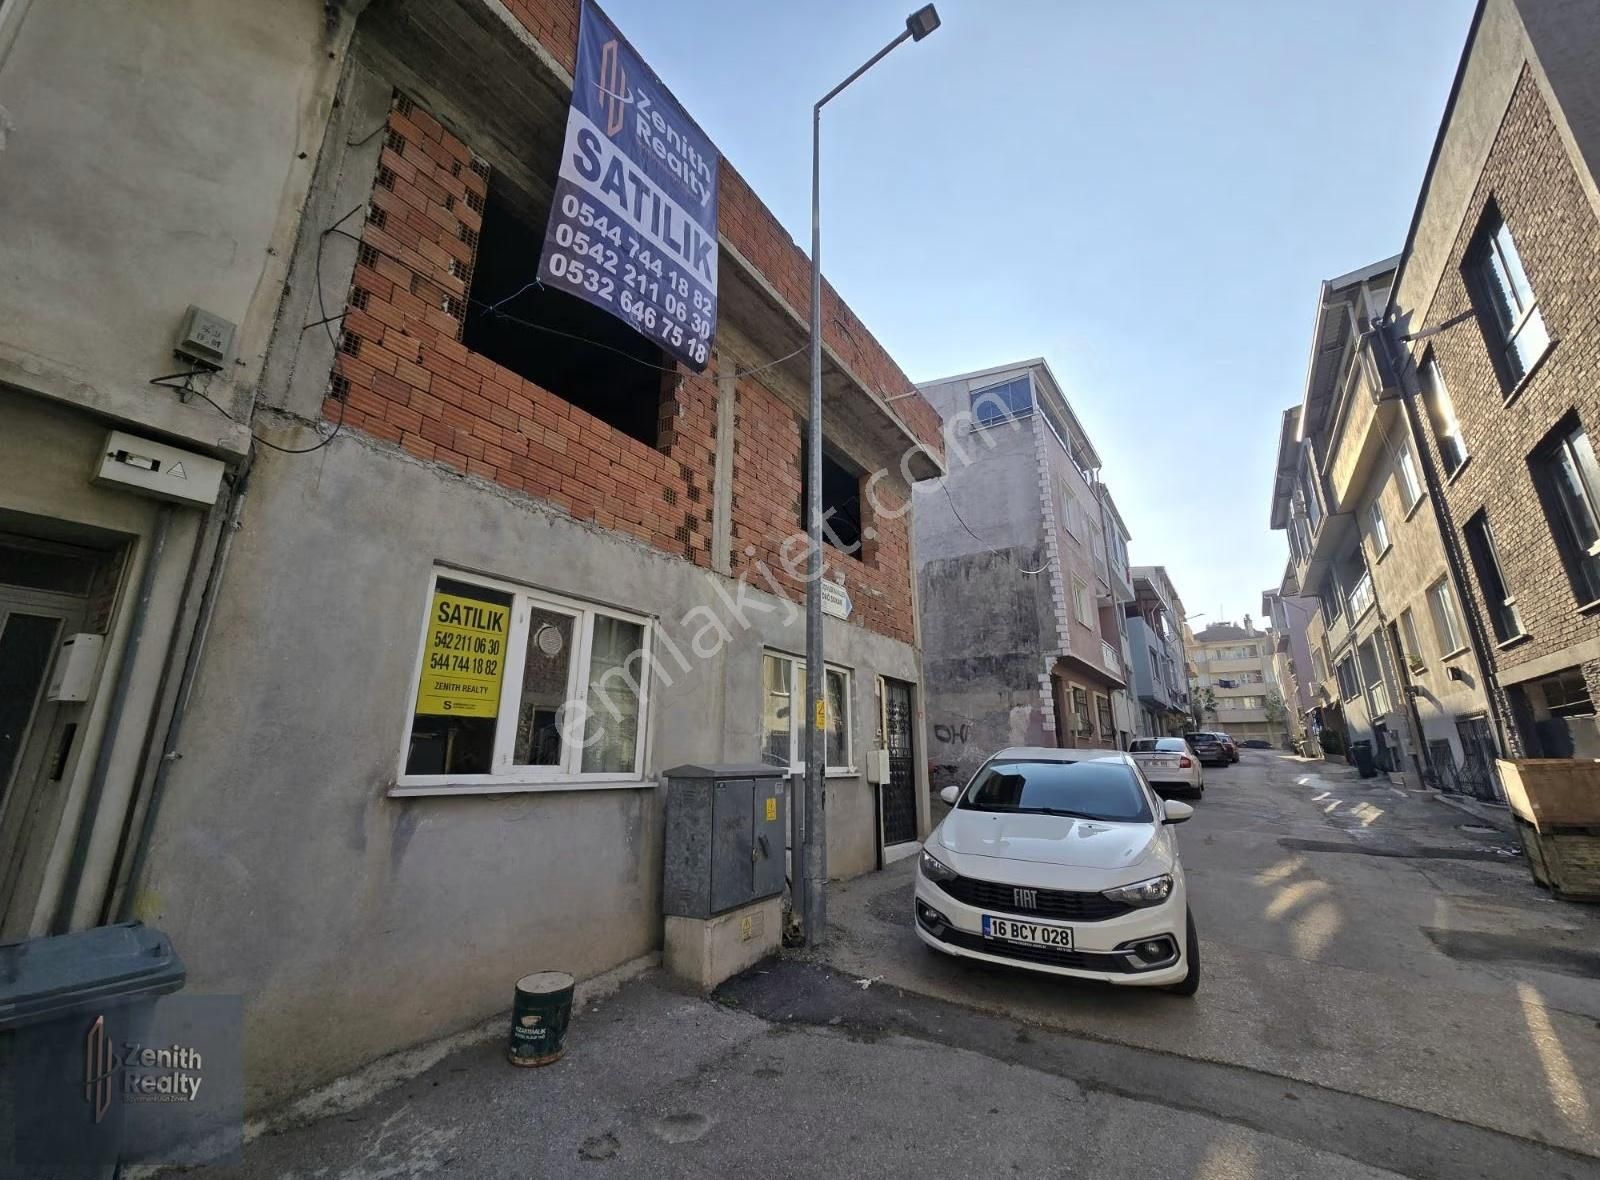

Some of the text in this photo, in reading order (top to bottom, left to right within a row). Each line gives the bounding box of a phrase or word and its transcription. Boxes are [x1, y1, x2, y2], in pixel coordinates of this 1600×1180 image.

[636, 113, 710, 207] Realty
[637, 88, 710, 183] Zenith
[573, 128, 713, 284] SATILIK
[556, 224, 710, 339] 0542 211 06 30
[562, 194, 712, 317] 0544 744 18 82
[549, 253, 706, 364] 0532 646 75 18
[434, 631, 499, 655] 542 211 06 30
[438, 602, 504, 632] SATILIK
[430, 653, 497, 676] 544 744 18 82
[434, 682, 488, 695] ZENITH REALTY
[1013, 888, 1038, 909] FIAT
[992, 920, 1007, 936] 16
[1010, 923, 1038, 941] BCY
[1041, 928, 1069, 945] 028
